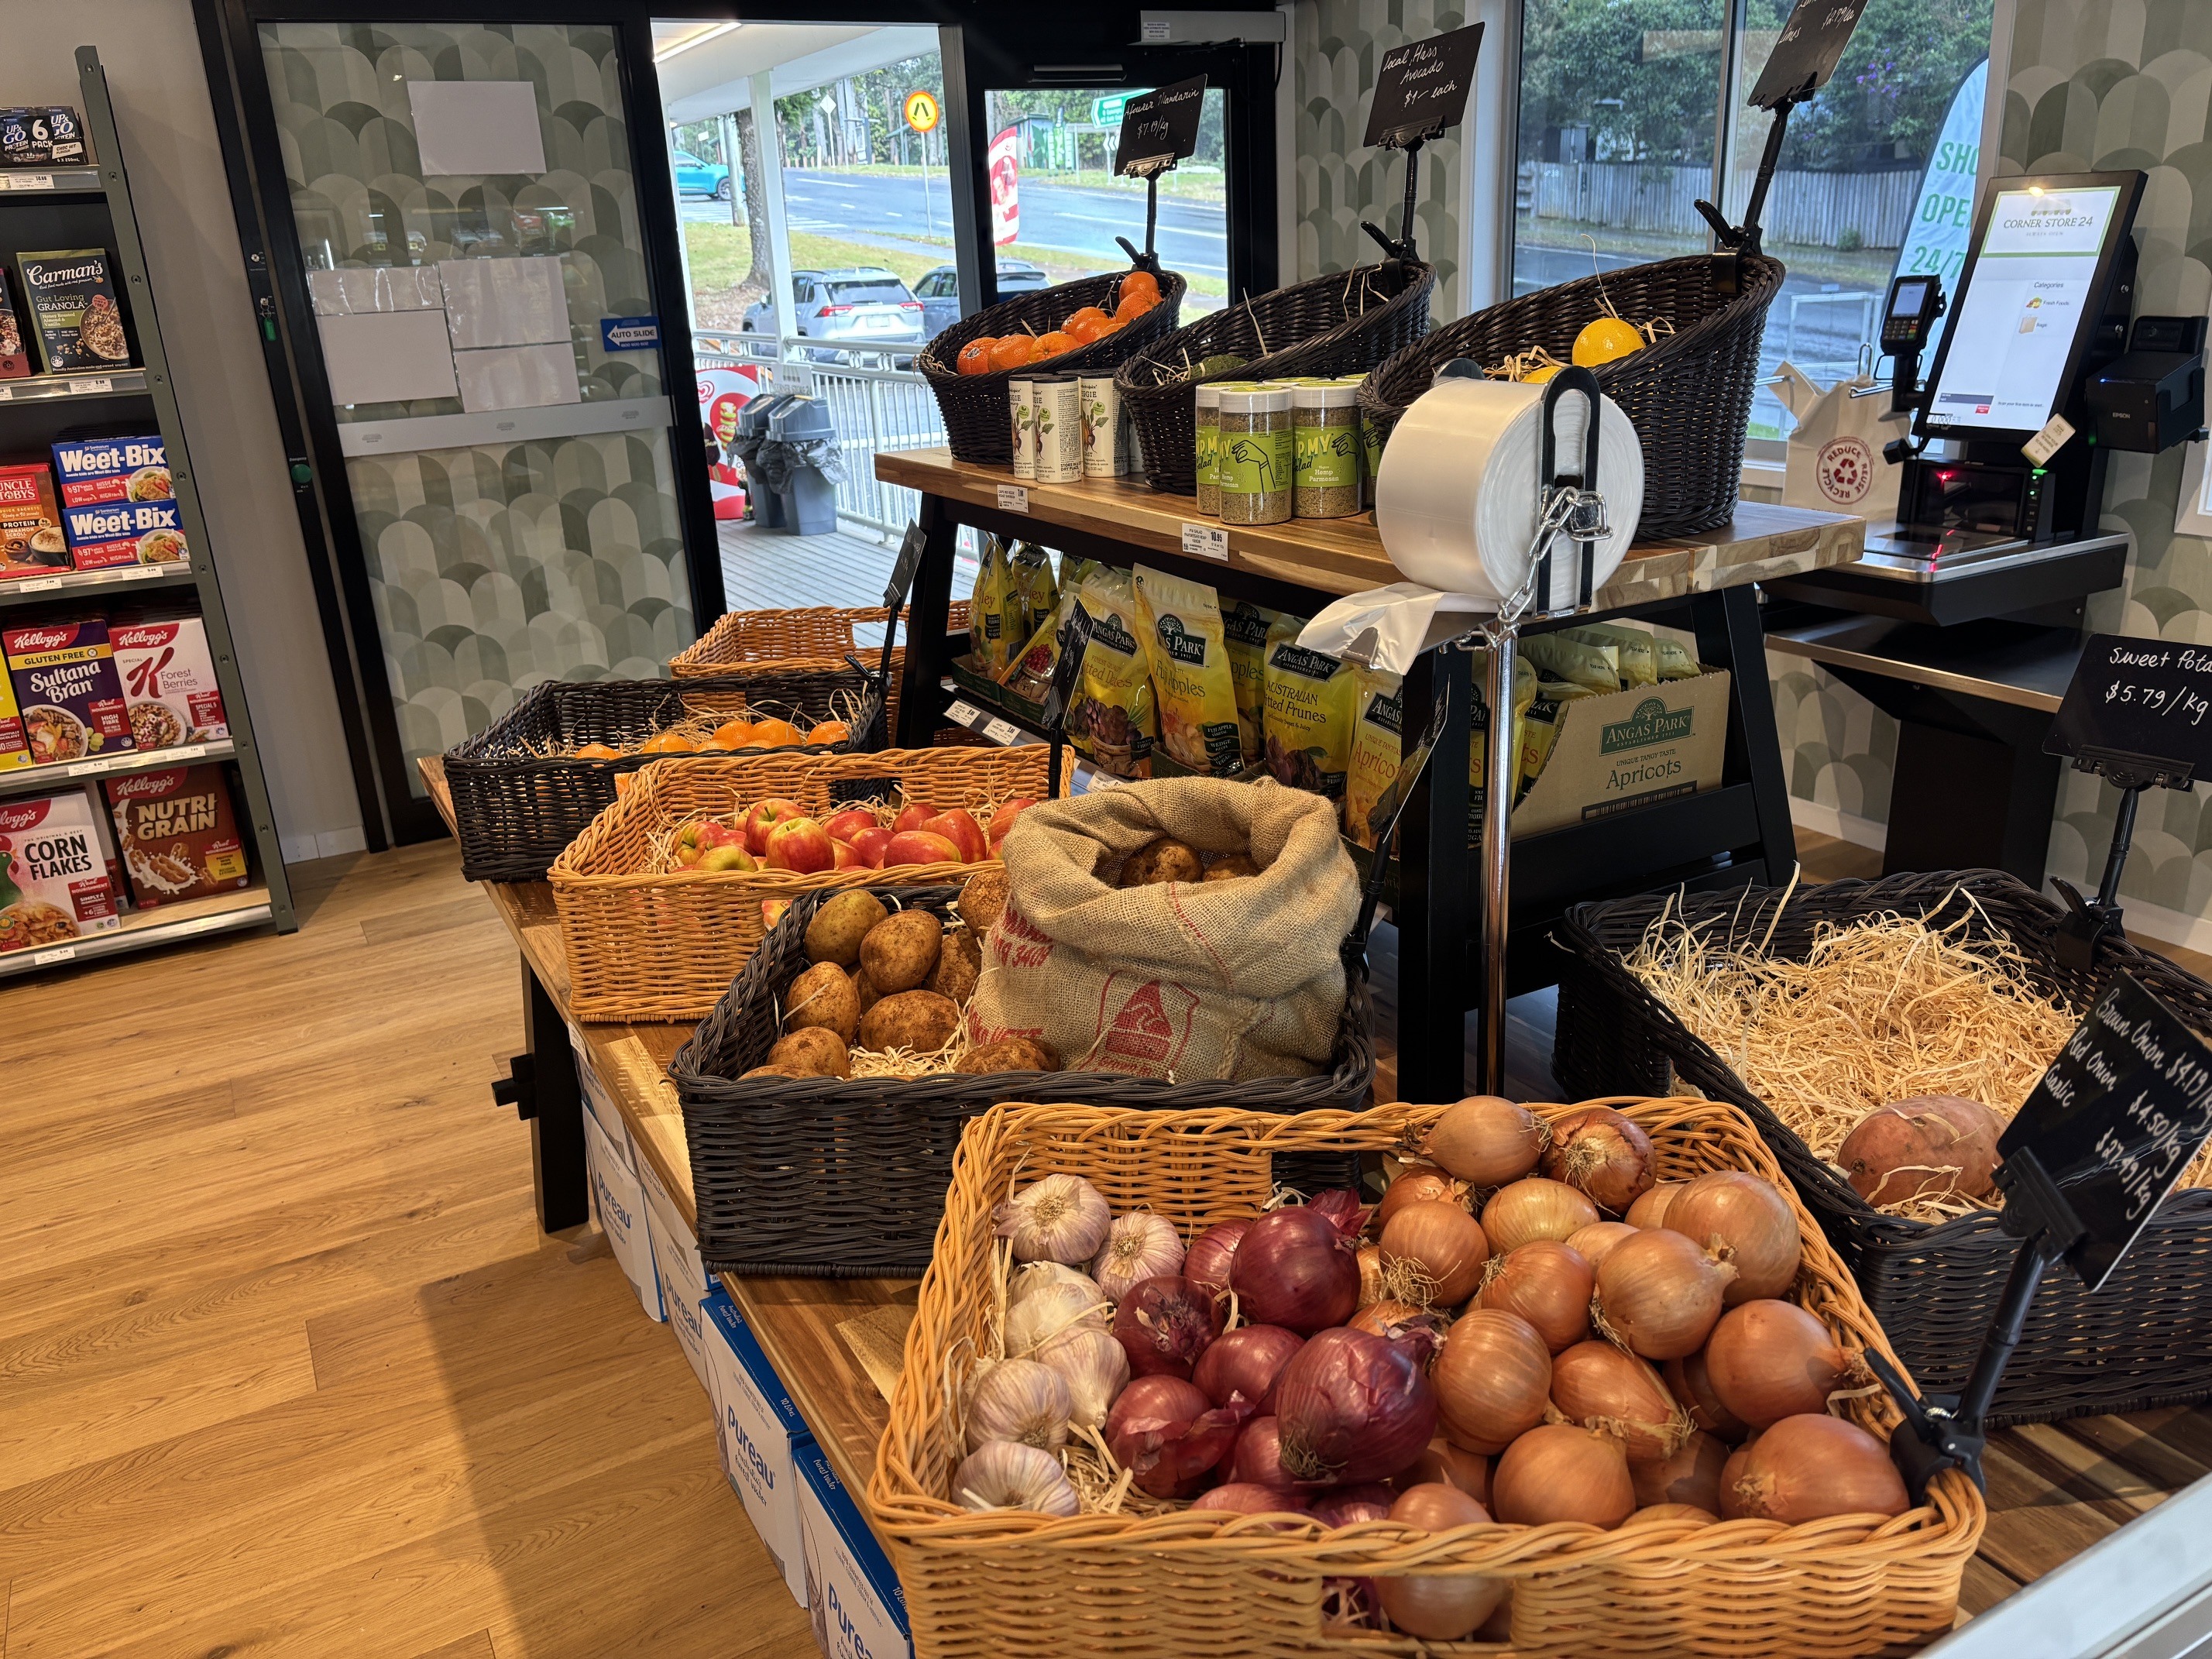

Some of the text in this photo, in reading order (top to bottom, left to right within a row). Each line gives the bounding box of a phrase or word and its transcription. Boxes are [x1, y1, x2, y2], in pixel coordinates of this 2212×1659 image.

[1383, 49, 1410, 72] Local
[1400, 60, 1444, 85] Avocado
[1431, 80, 1457, 98] each
[3, 131, 26, 144] GO
[33, 119, 48, 139] 6
[5, 139, 28, 151] PROTEIN
[1936, 142, 1979, 177] SHO
[1921, 194, 1971, 228] OPE
[2004, 216, 2094, 228] CORNER STORE 24
[26, 259, 103, 285] Carman's
[1909, 246, 1966, 279] 24/7
[37, 301, 85, 311] GRANOLA
[60, 445, 167, 472] Weet-Bix
[1827, 445, 1862, 462] REDUCE
[1822, 466, 1851, 499] RECYCLE
[1853, 462, 1868, 495] REUSE
[70, 507, 177, 536] Weet-Bix
[1211, 531, 1222, 542] 10.95
[14, 631, 67, 649] Kellogg's
[119, 630, 168, 646] Kellogg's
[1093, 622, 1136, 648] ANGAS PARK
[1175, 636, 1201, 656] PARK
[24, 651, 85, 665] GLUTEN FREE
[1277, 649, 1332, 674] ANGAS PARK
[2110, 647, 2212, 672] Sweet Pota
[30, 661, 101, 692] Sultana
[126, 647, 174, 698] K
[161, 668, 192, 680] Forest
[163, 677, 198, 689] Berries
[1106, 672, 1132, 688] Dates
[1169, 668, 1205, 697] Apples
[1231, 661, 1264, 681] pples
[46, 679, 94, 702] Bran
[1266, 681, 1318, 706] AUSTRALIAN
[1264, 695, 1327, 723] itted Prunes
[1372, 699, 1400, 723] ANGAS
[1606, 716, 1688, 744] ANGAS PARK
[1617, 735, 1659, 747] ESTABLISHED
[1354, 740, 1400, 778] Aprico
[1616, 748, 1676, 766] UNIQUE TANGY TASTE
[117, 775, 175, 796] Kellogg's
[1606, 760, 1681, 791] Apricots
[0, 809, 37, 828] logg's
[136, 793, 216, 823] NUTRI
[137, 810, 215, 840] GRAIN
[25, 834, 88, 864] CORN
[29, 855, 92, 881] FLAKES
[71, 883, 108, 893] NOURISHMENT
[2131, 1019, 2165, 1070] Onion
[2068, 1026, 2092, 1062] Red
[2086, 1050, 2118, 1092] Onion
[2045, 1063, 2075, 1108] Garlic
[598, 1171, 631, 1229] pureau
[665, 1273, 702, 1340] pureau
[728, 1404, 775, 1490] pureau
[828, 1582, 874, 1659] pure
